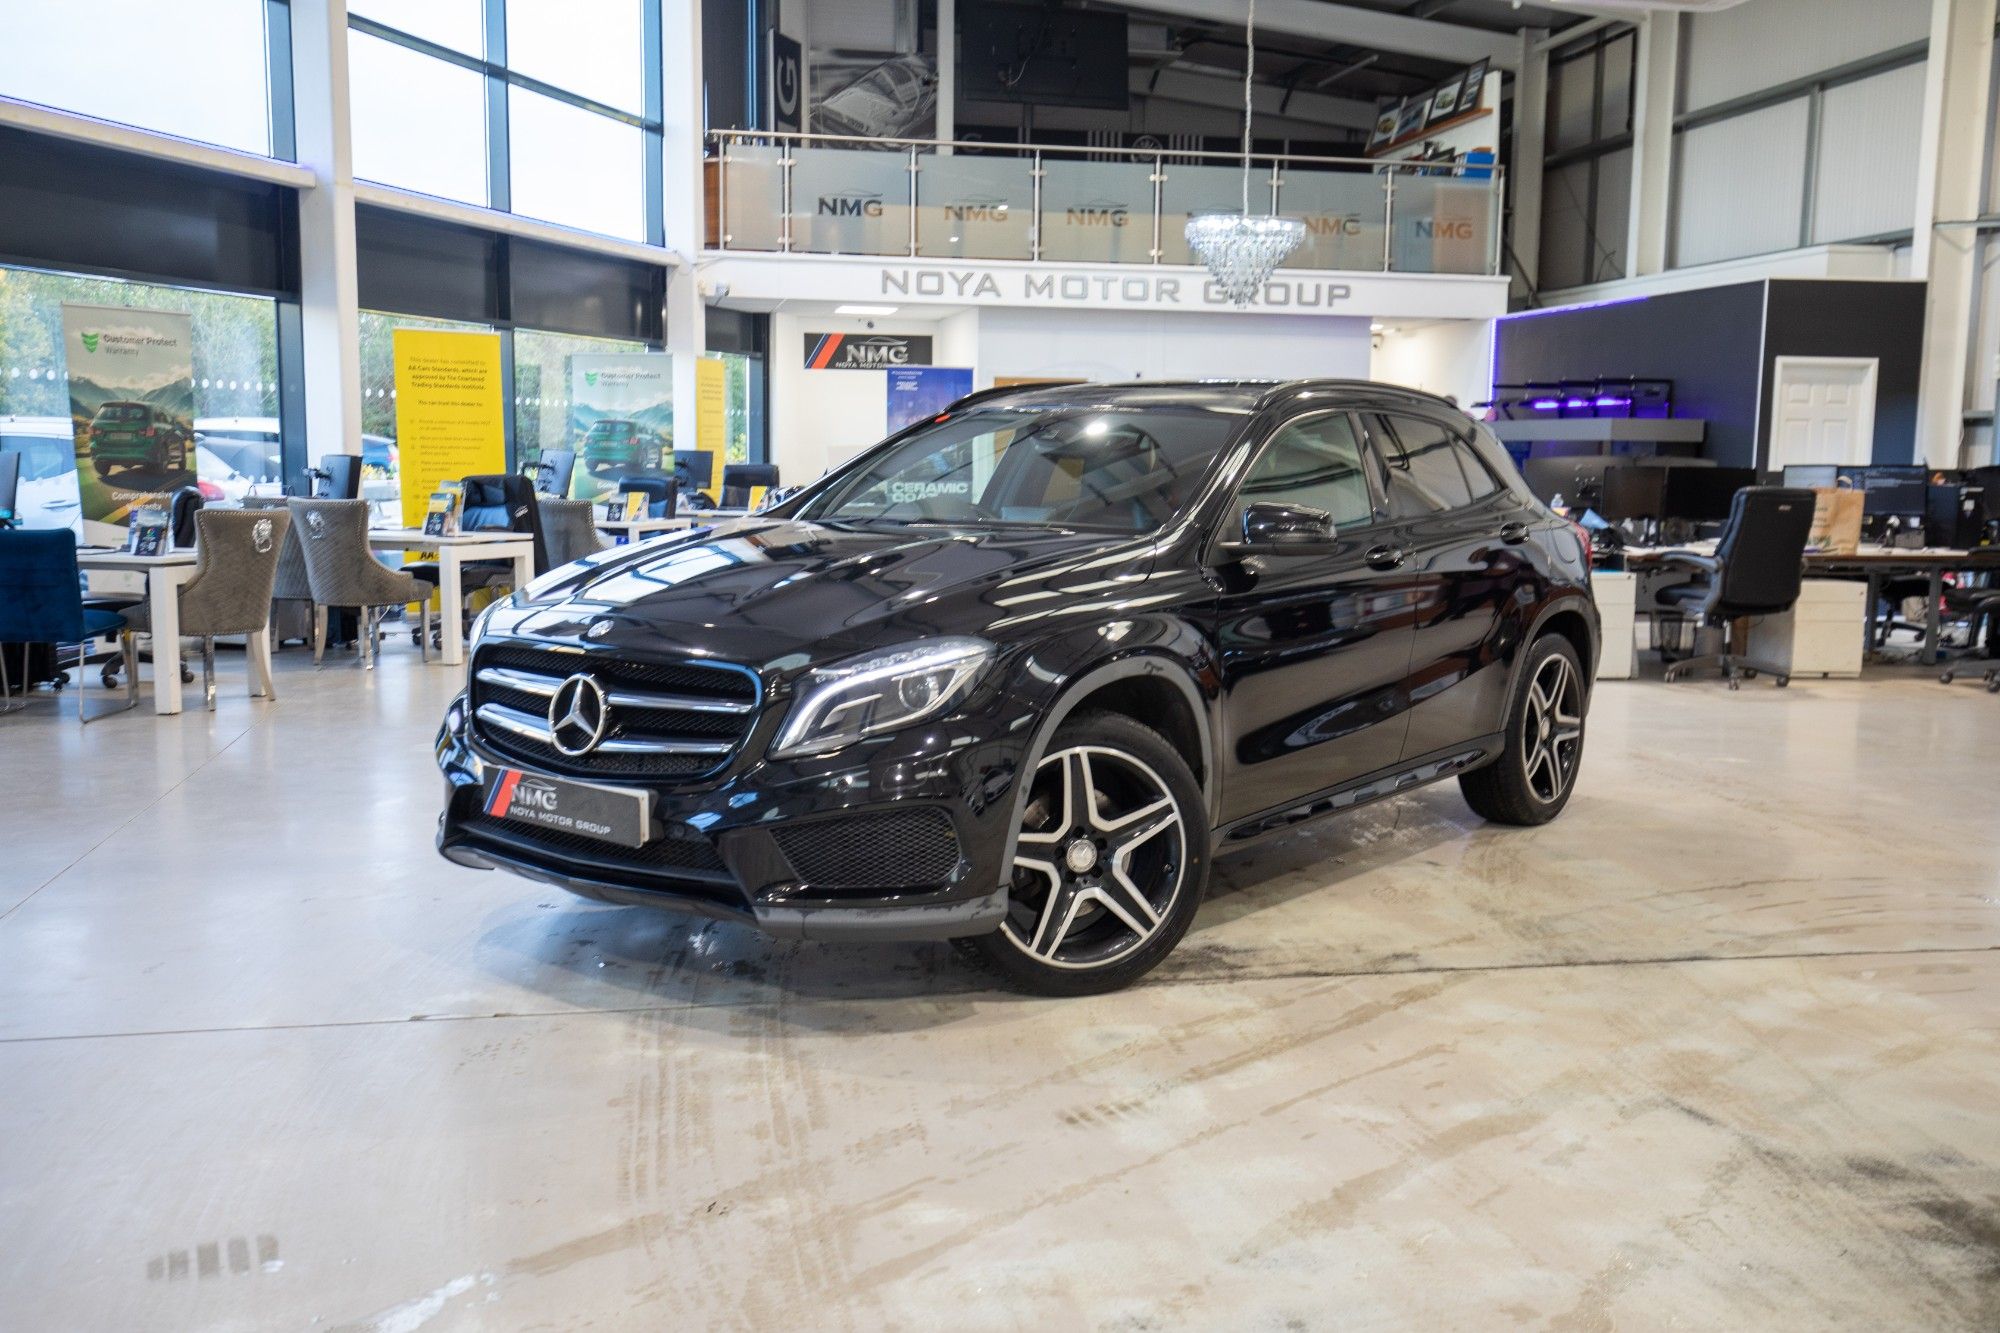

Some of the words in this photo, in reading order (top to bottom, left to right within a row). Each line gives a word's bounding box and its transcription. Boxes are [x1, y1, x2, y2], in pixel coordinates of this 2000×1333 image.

[818, 197, 883, 217] NMG
[944, 205, 1008, 222] NMG
[1066, 207, 1130, 227] NMG
[1304, 215, 1361, 236] NMG
[1415, 219, 1473, 240] NMG
[881, 269, 1001, 298] NOYA
[1024, 273, 1180, 302] MOTOR
[1203, 280, 1351, 308] GOUP
[846, 343, 909, 364] NMG
[892, 482, 969, 494] CERAMIC
[510, 784, 558, 811] NMG
[510, 805, 537, 819] NOYA
[538, 811, 574, 828] MOTOR
[575, 819, 611, 836] GROUP
